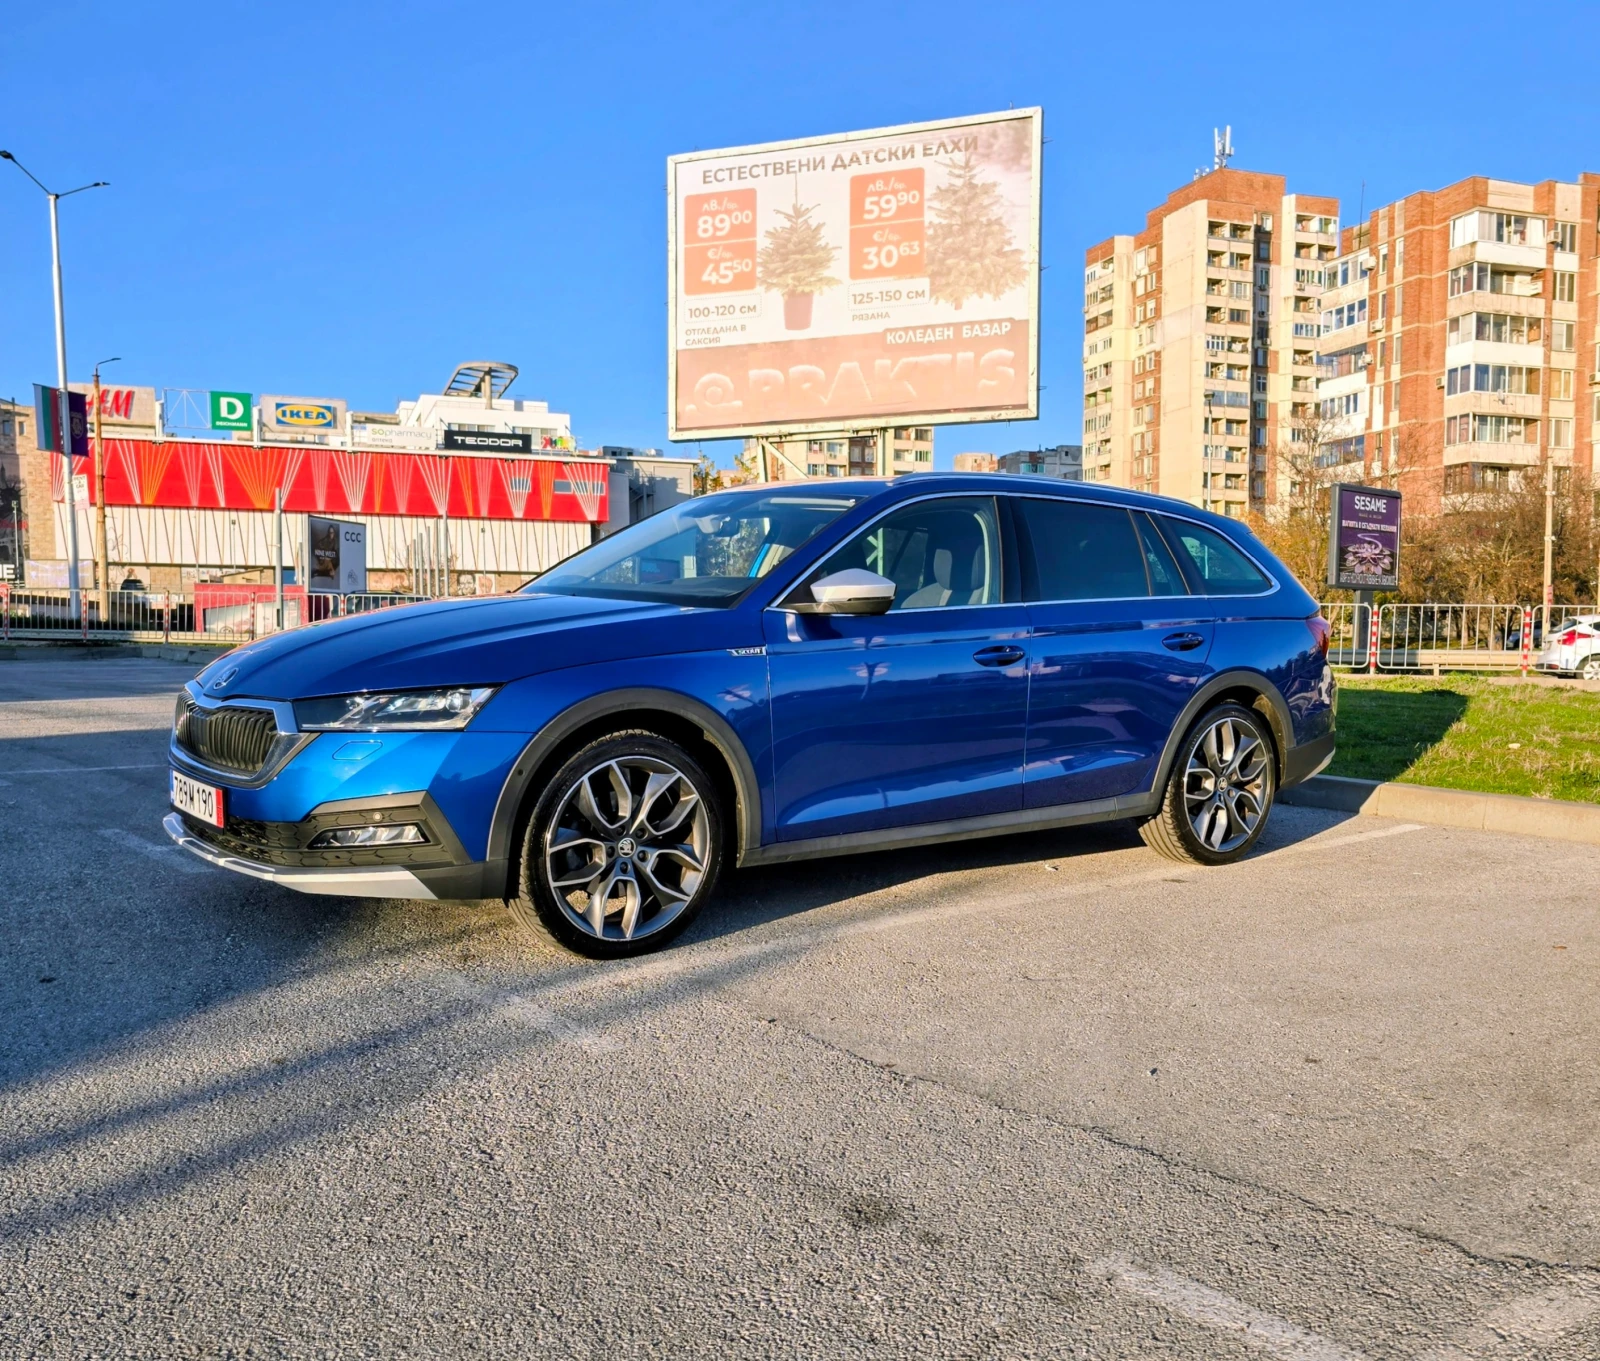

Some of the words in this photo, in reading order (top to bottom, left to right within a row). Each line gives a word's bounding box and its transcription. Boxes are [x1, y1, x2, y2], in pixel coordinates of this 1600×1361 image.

[702, 156, 825, 184] ЕСТЕСТВЕНИ
[831, 146, 916, 172] ДАТСКИ
[922, 136, 979, 158] ЕЛХИ
[852, 289, 902, 305] 125-150
[688, 304, 736, 319] 100-120
[852, 311, 891, 321] РЯЗАНА
[685, 324, 738, 336] ОТГЛЕДАНА
[887, 326, 954, 344] КОЛЕДЕН
[962, 321, 1012, 338] БАЗАР
[685, 336, 721, 346] САКСИЯ
[219, 396, 244, 420] D
[281, 409, 328, 420] IKEA
[453, 435, 523, 447] TEODOR
[1354, 495, 1387, 513] SESAME
[344, 531, 362, 543] CCC
